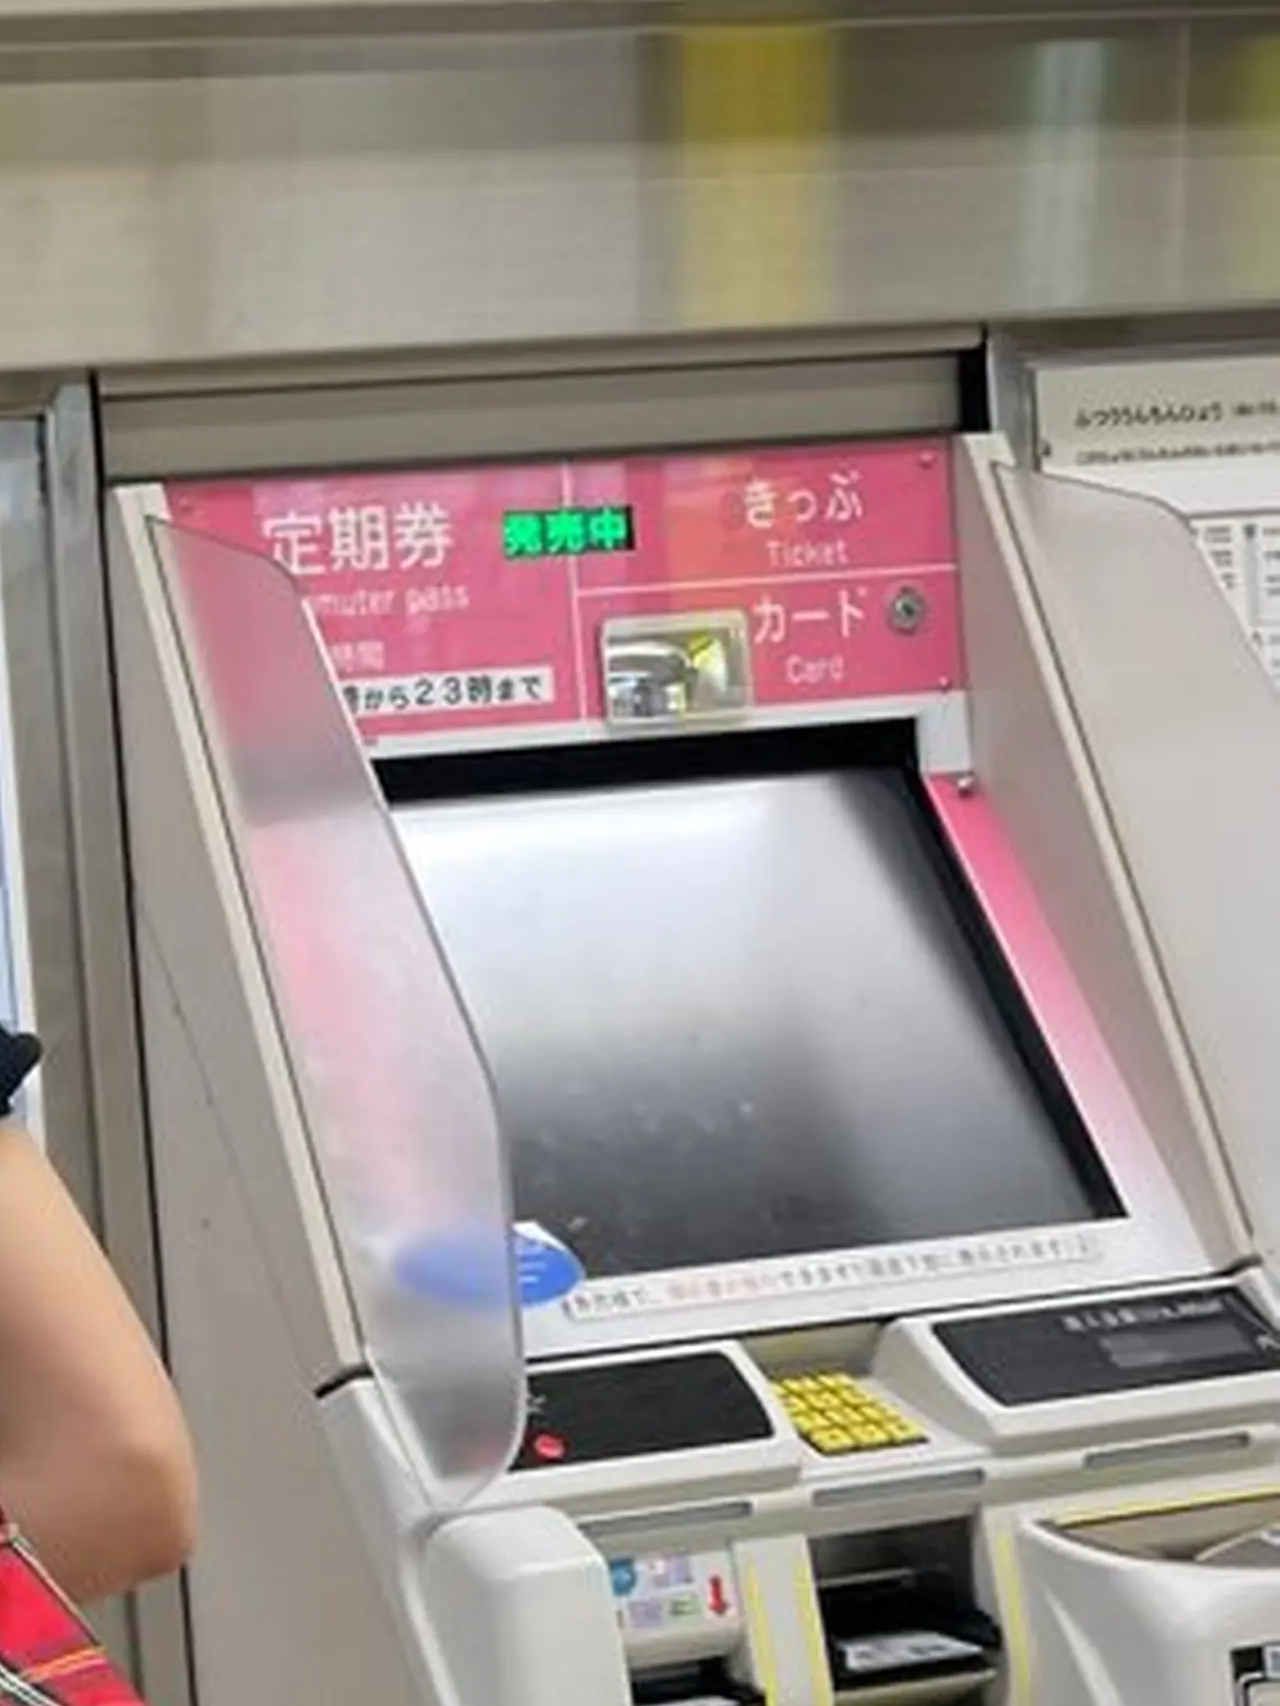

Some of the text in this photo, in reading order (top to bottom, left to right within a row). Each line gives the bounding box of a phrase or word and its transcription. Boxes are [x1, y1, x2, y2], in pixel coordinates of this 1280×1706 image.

[744, 470, 863, 529] きっぷ
[263, 502, 452, 575] 定期券
[504, 509, 626, 555] 発売中
[767, 540, 848, 566] Ticket
[753, 588, 867, 643] カード
[787, 654, 844, 683] Card
